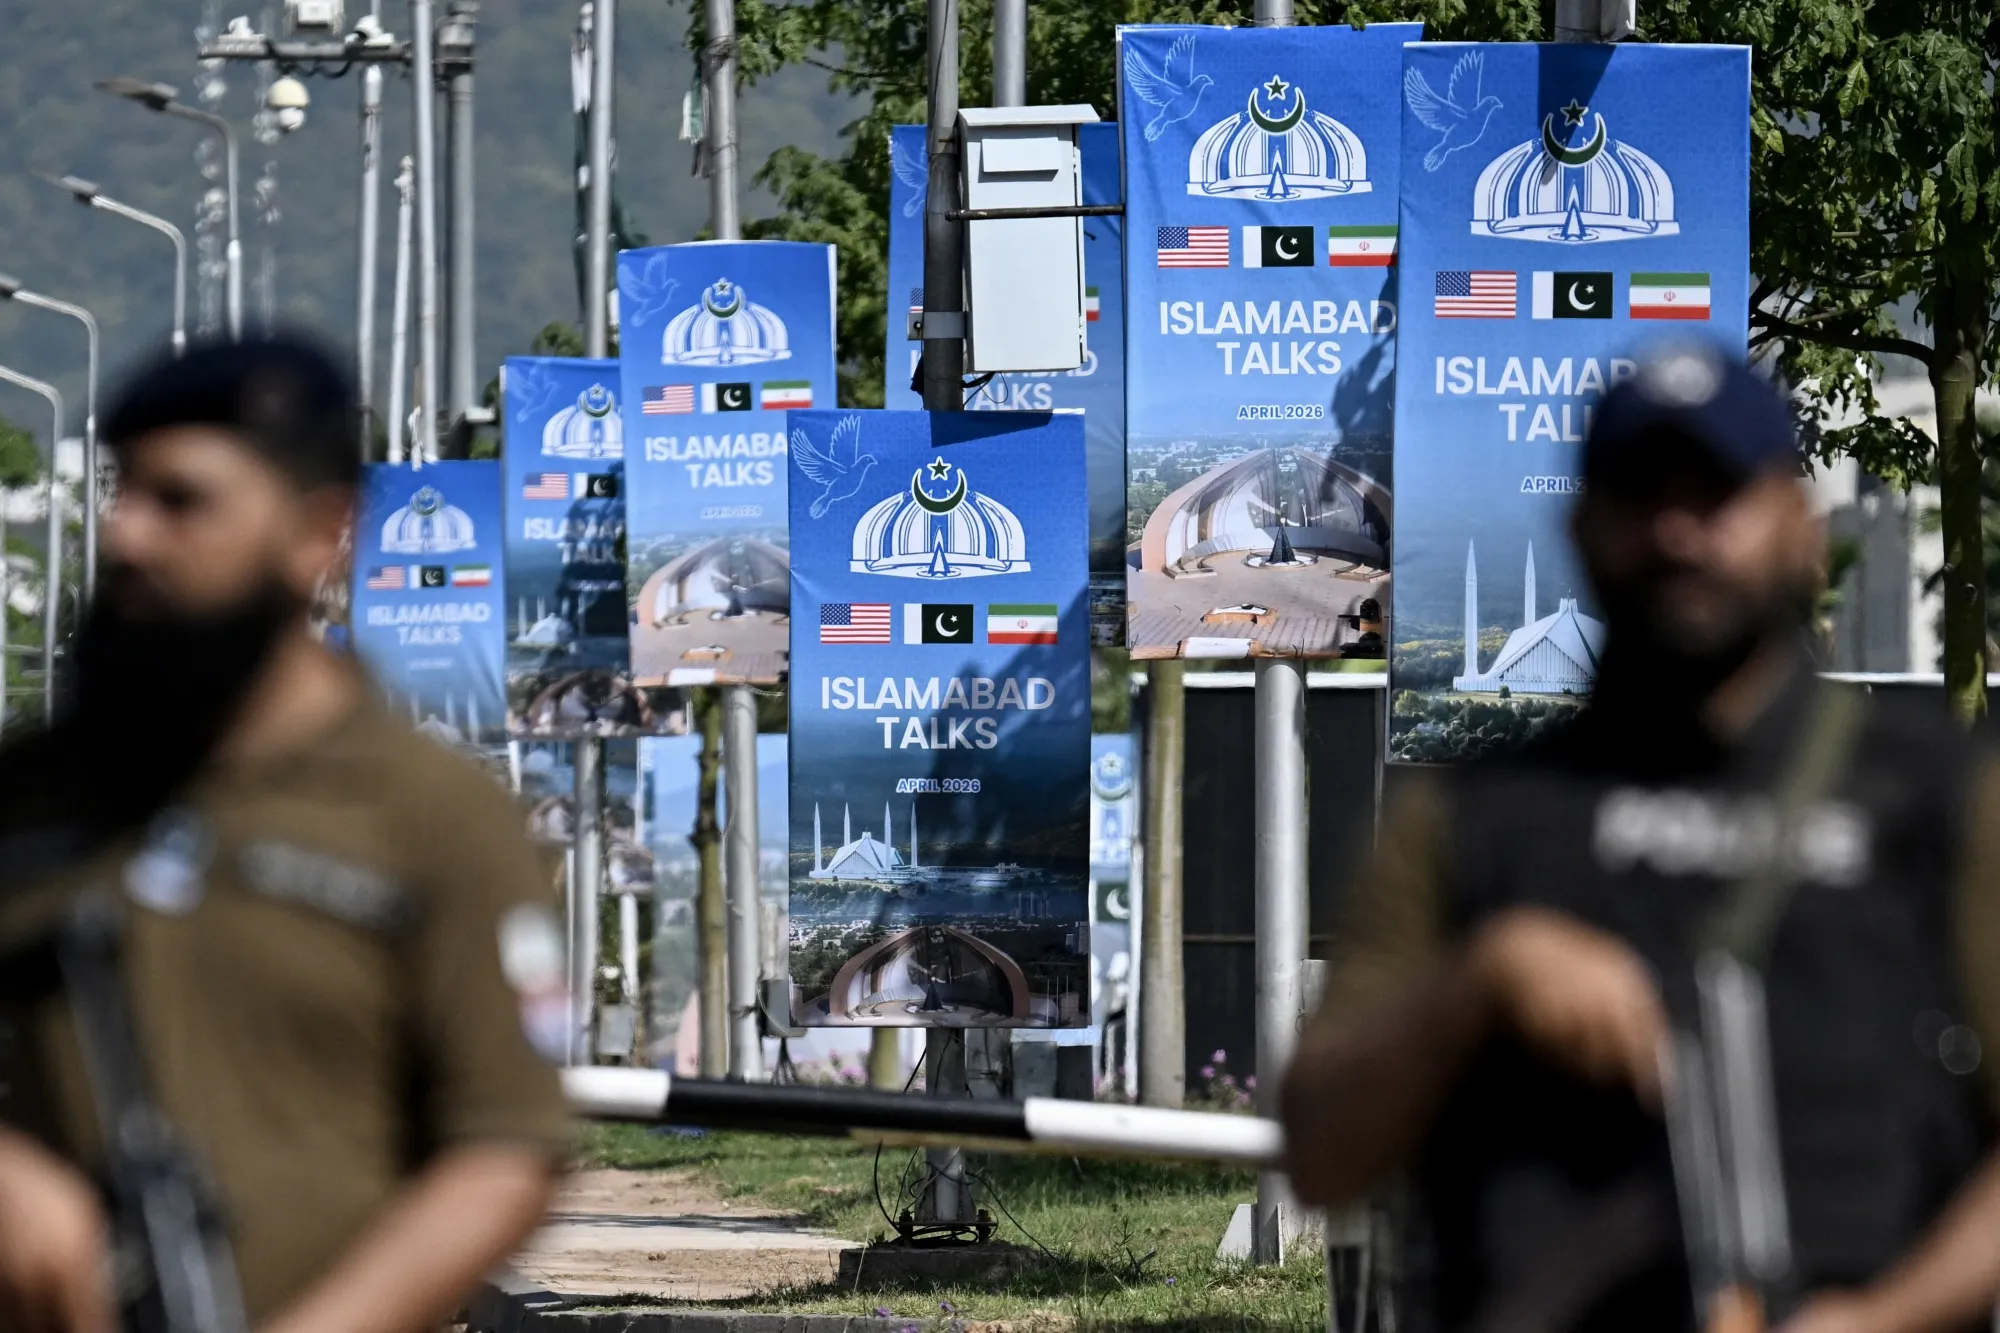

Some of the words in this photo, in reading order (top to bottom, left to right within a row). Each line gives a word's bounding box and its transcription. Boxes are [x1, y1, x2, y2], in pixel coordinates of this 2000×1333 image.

[1160, 300, 1397, 335] ISLAMABAD
[1216, 341, 1342, 375] TALKS
[963, 382, 1053, 411] ALKS
[1237, 405, 1283, 420] APRIL
[1285, 404, 1324, 420] 2026
[1499, 403, 1592, 442] TAL
[644, 432, 788, 461] ISLAMABA
[684, 460, 774, 488] TALKS
[1521, 476, 1572, 493] APRIL
[557, 542, 617, 564] TALK
[366, 602, 492, 626] ISLAMABAD
[396, 625, 462, 646] TALKS
[821, 676, 1056, 710] ISLAMABAD
[876, 716, 998, 749] TALKS
[896, 778, 940, 793] APRIL
[942, 778, 981, 793] 2026
